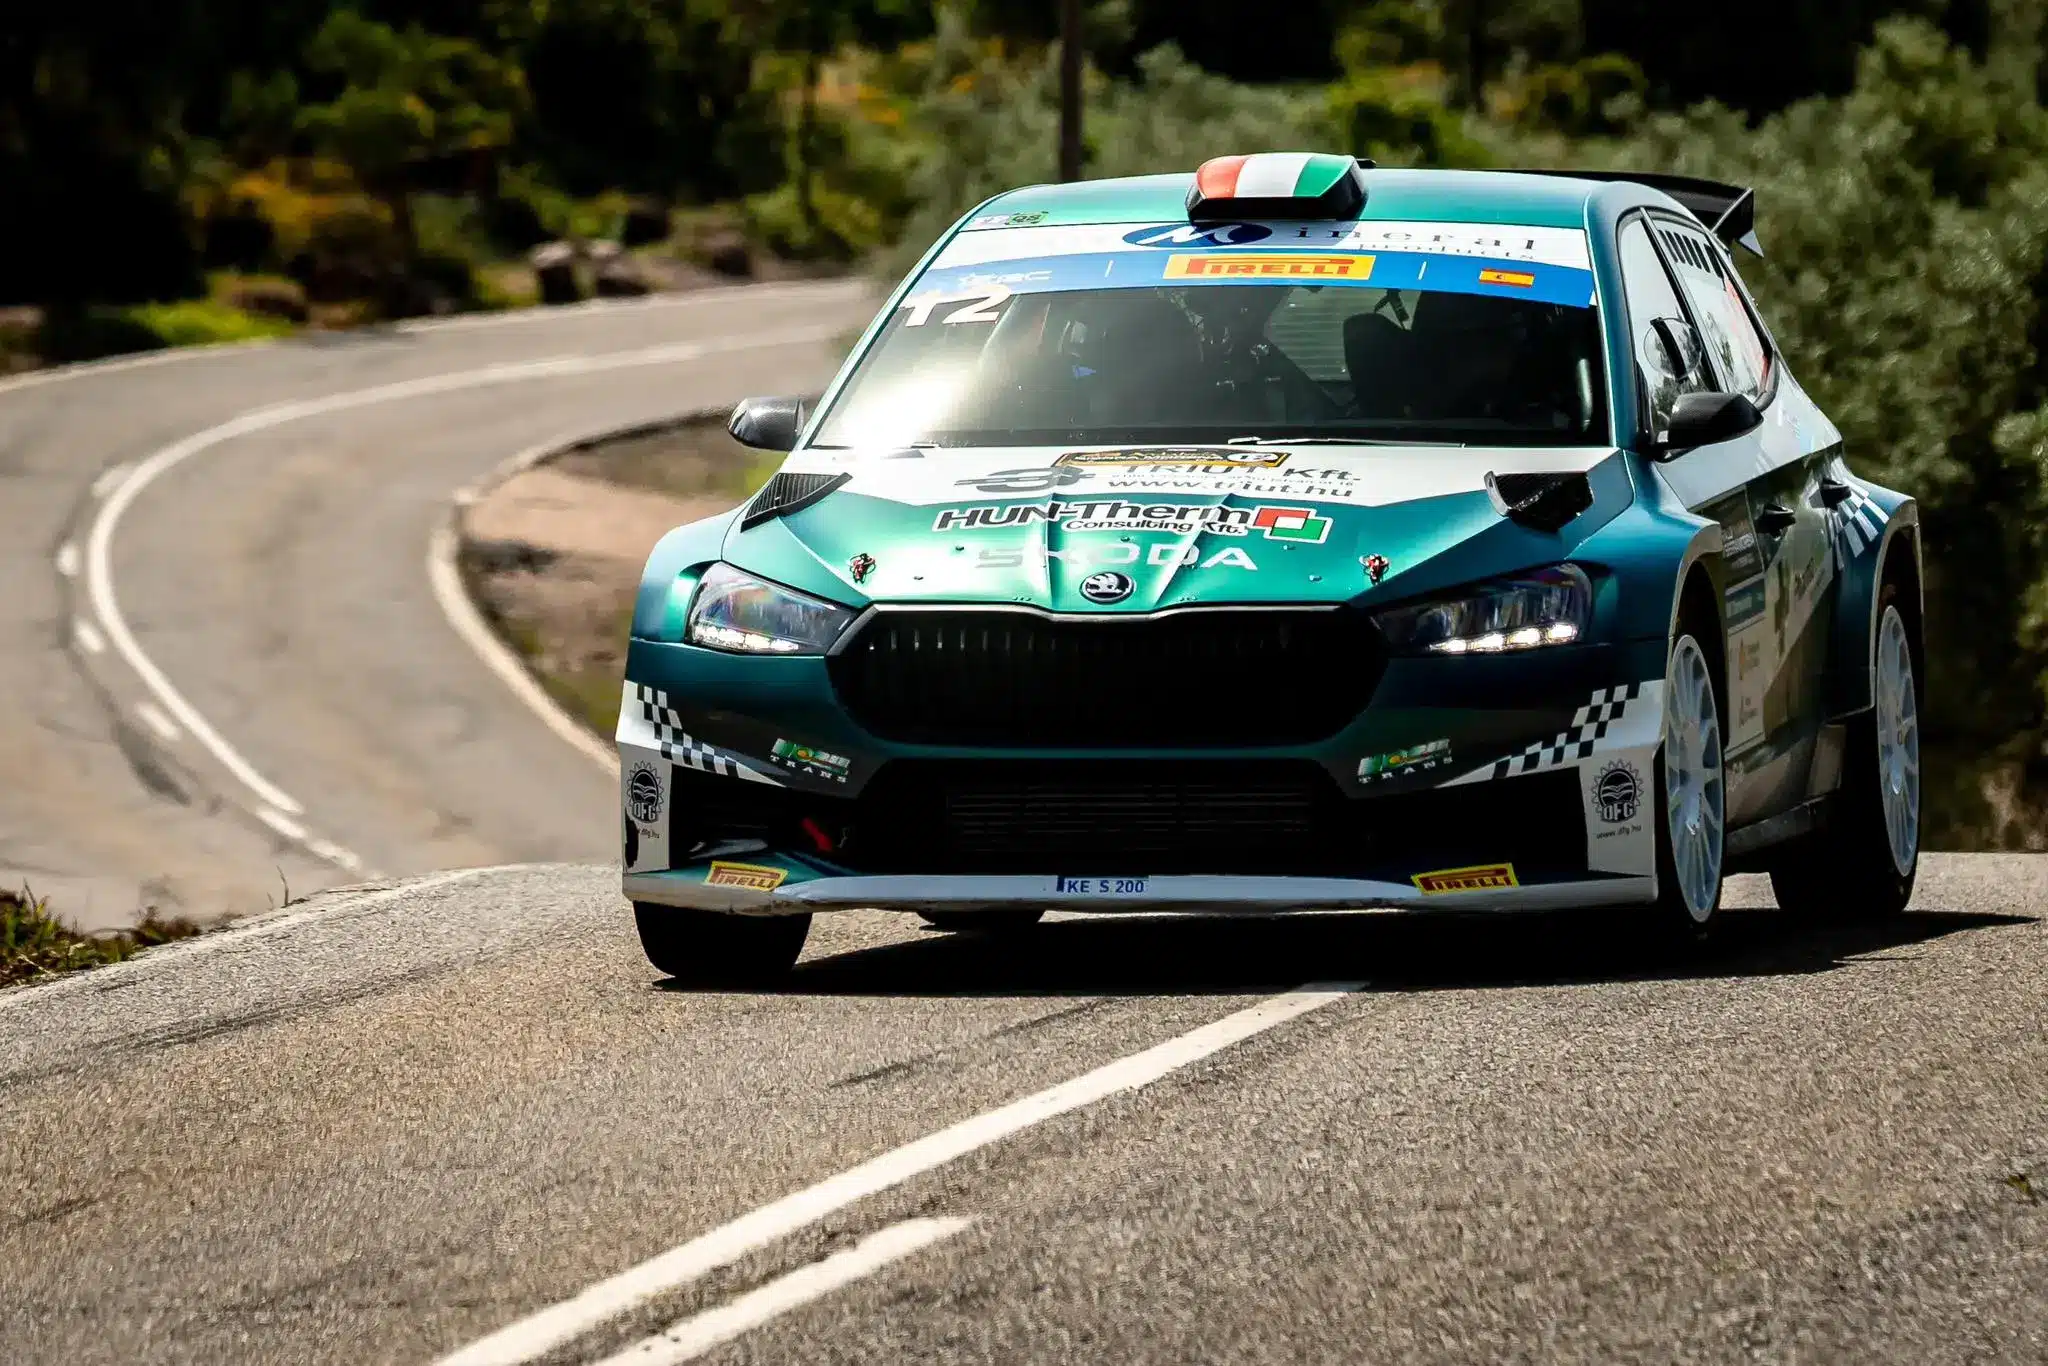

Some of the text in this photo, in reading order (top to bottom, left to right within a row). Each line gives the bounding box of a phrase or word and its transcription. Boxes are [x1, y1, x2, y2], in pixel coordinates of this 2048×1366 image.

[1186, 257, 1356, 276] PIRELLI
[899, 284, 1012, 327] 12
[938, 501, 1252, 529] HUN-Therm
[1066, 519, 1246, 535] Consulting Kft.
[769, 754, 848, 784] TRANS
[709, 865, 780, 890] PIRELLI
[1067, 880, 1091, 893] KE
[1115, 880, 1145, 893] 200
[1418, 867, 1513, 893] PIRELLI
